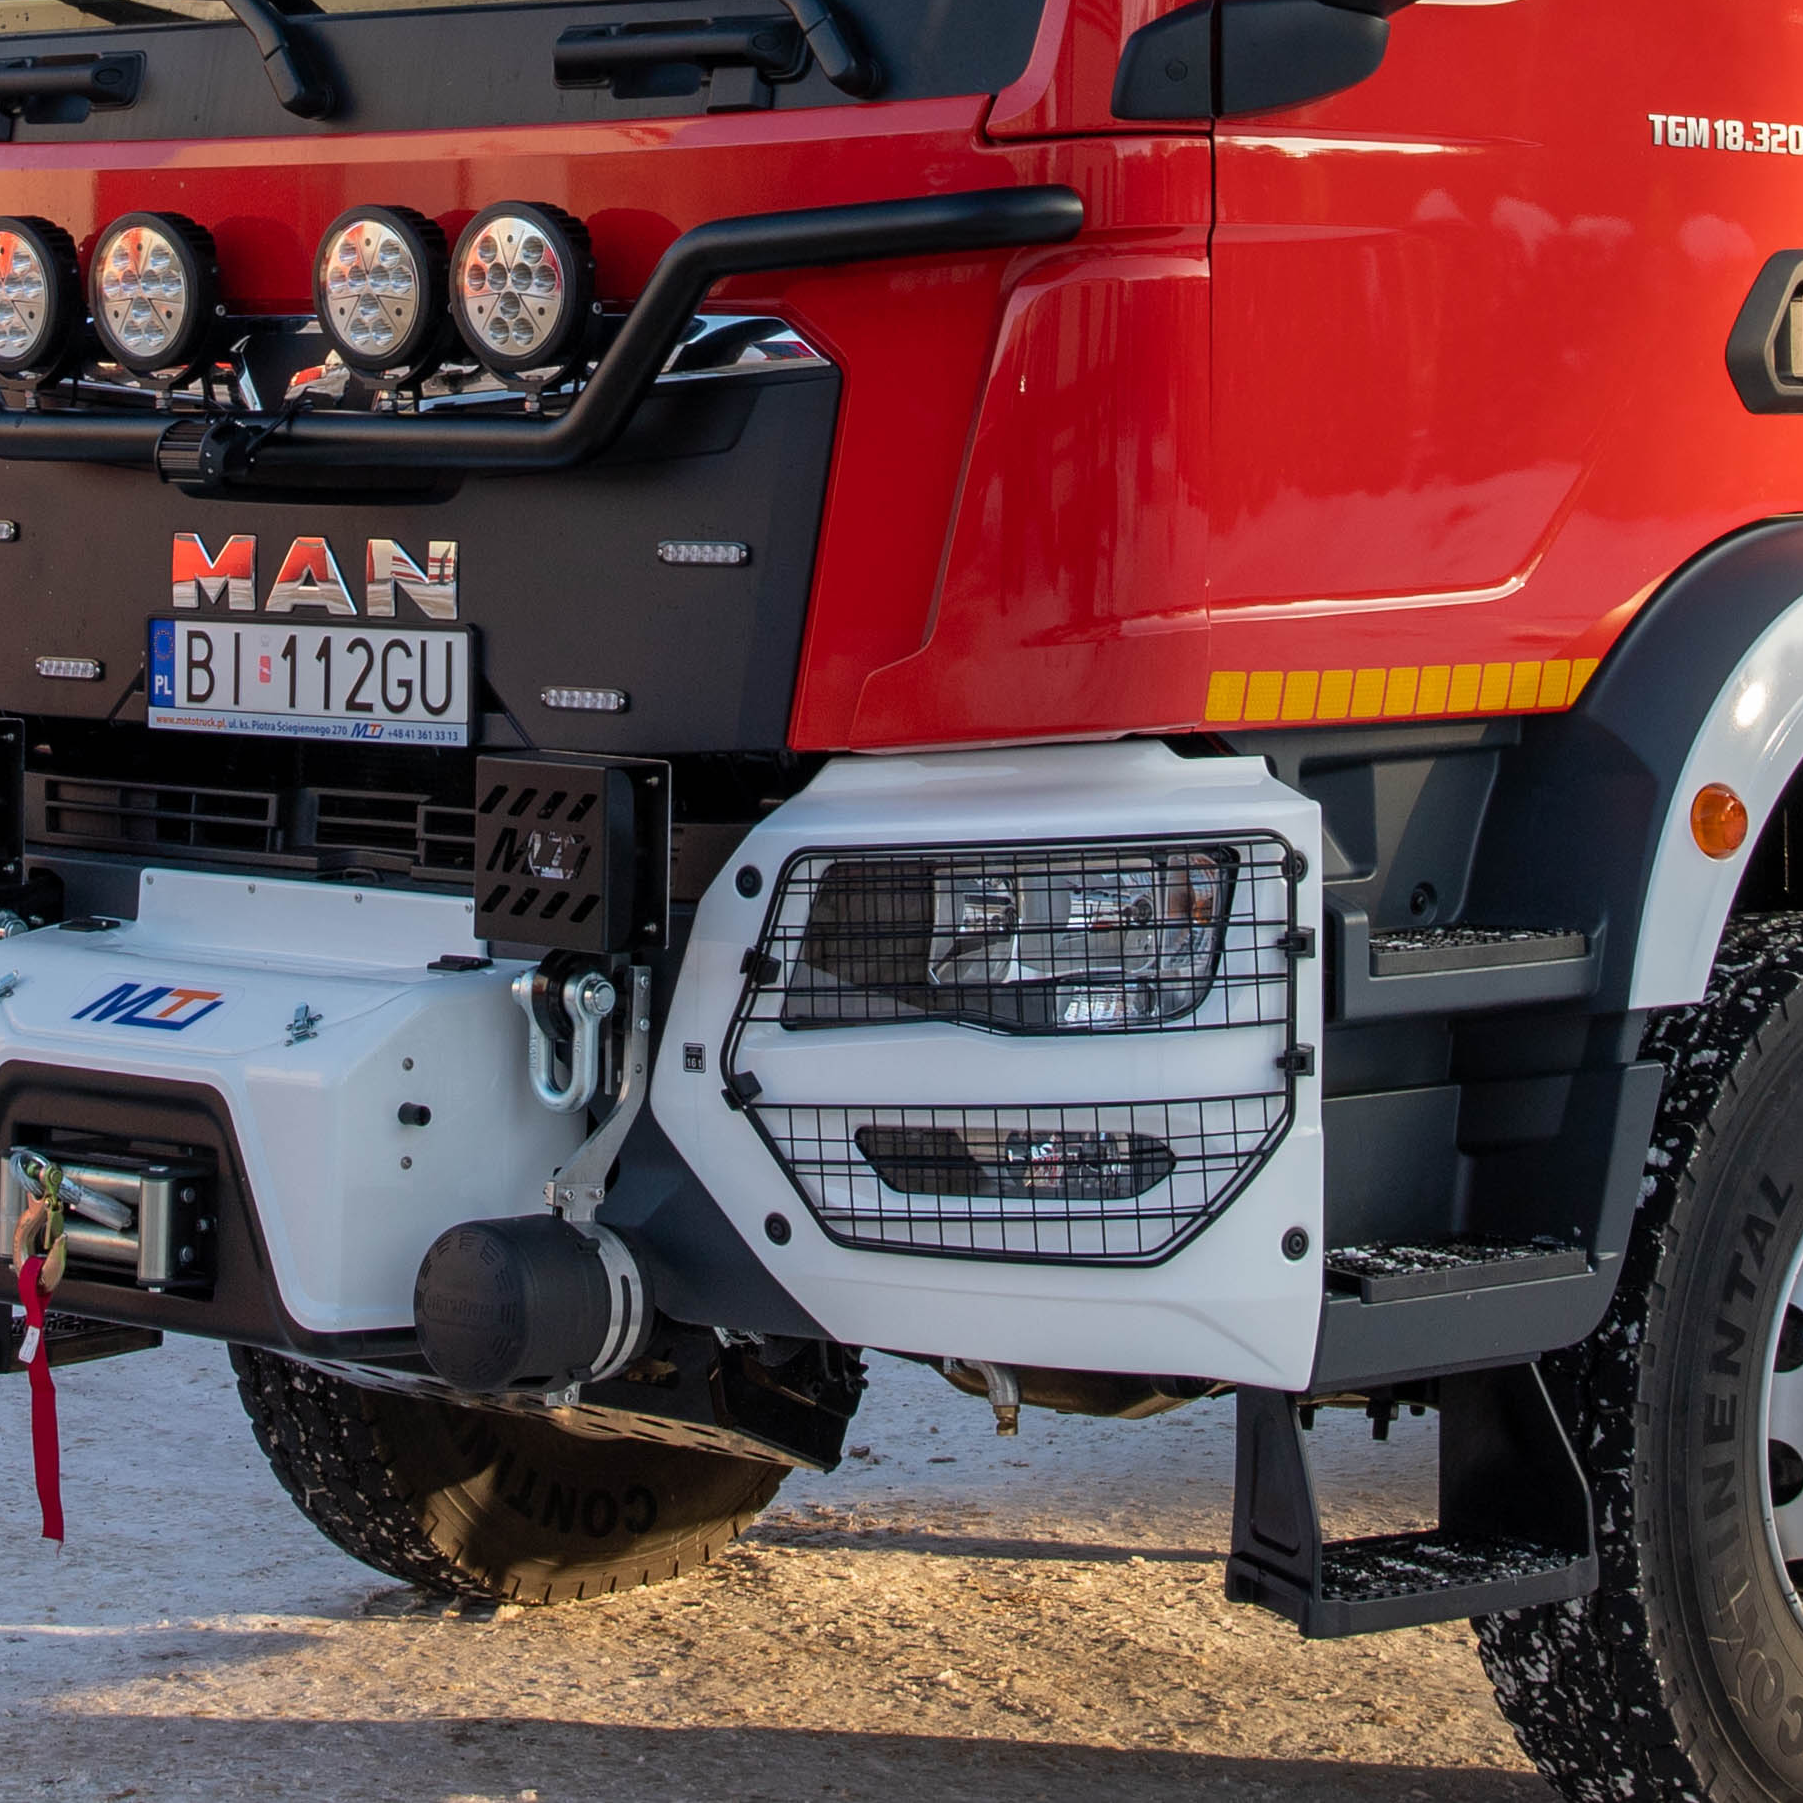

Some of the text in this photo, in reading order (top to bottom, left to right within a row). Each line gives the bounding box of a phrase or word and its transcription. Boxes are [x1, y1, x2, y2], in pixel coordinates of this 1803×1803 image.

[1648, 113, 1710, 149] TGM
[172, 532, 458, 620] MAN
[154, 629, 453, 716] PL BI 112GU
[252, 720, 276, 732] Piotra
[332, 725, 347, 735] 270
[388, 728, 404, 739] +48
[405, 729, 415, 739] 41
[418, 730, 433, 740] 361
[435, 730, 446, 741] 33
[448, 731, 458, 741] 13
